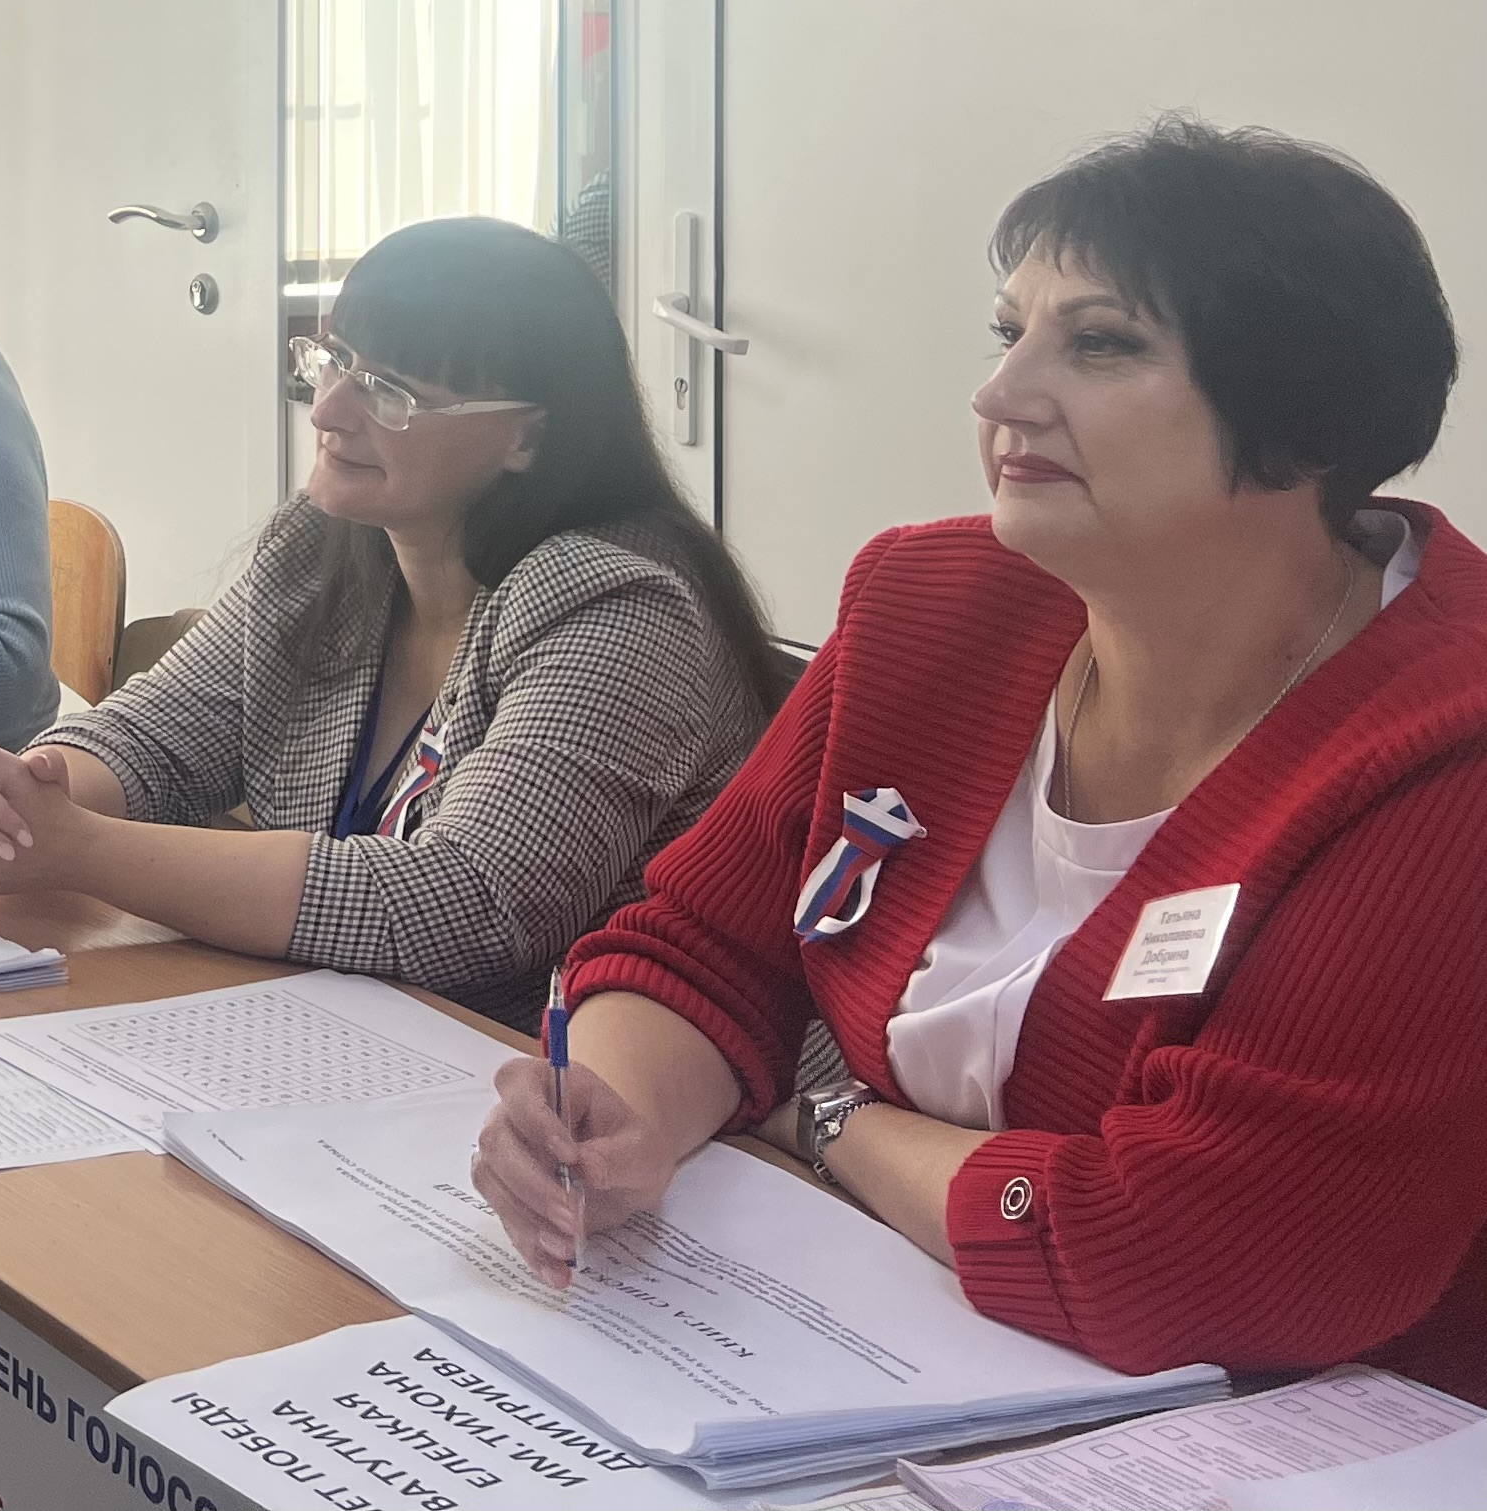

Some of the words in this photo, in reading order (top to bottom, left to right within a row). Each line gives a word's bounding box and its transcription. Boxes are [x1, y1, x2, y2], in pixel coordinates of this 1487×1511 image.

[579, 1266, 670, 1308] СПИСКА
[673, 1310, 756, 1358] КНИГА
[170, 1391, 326, 1483] ПОБЕДЫ
[271, 1399, 459, 1511] ВАТУТИНА
[332, 1392, 503, 1489] ЕЛЕЦКАЯ
[412, 1346, 650, 1472] ДМИТРИЕВА
[312, 1485, 382, 1511] ЕТ
